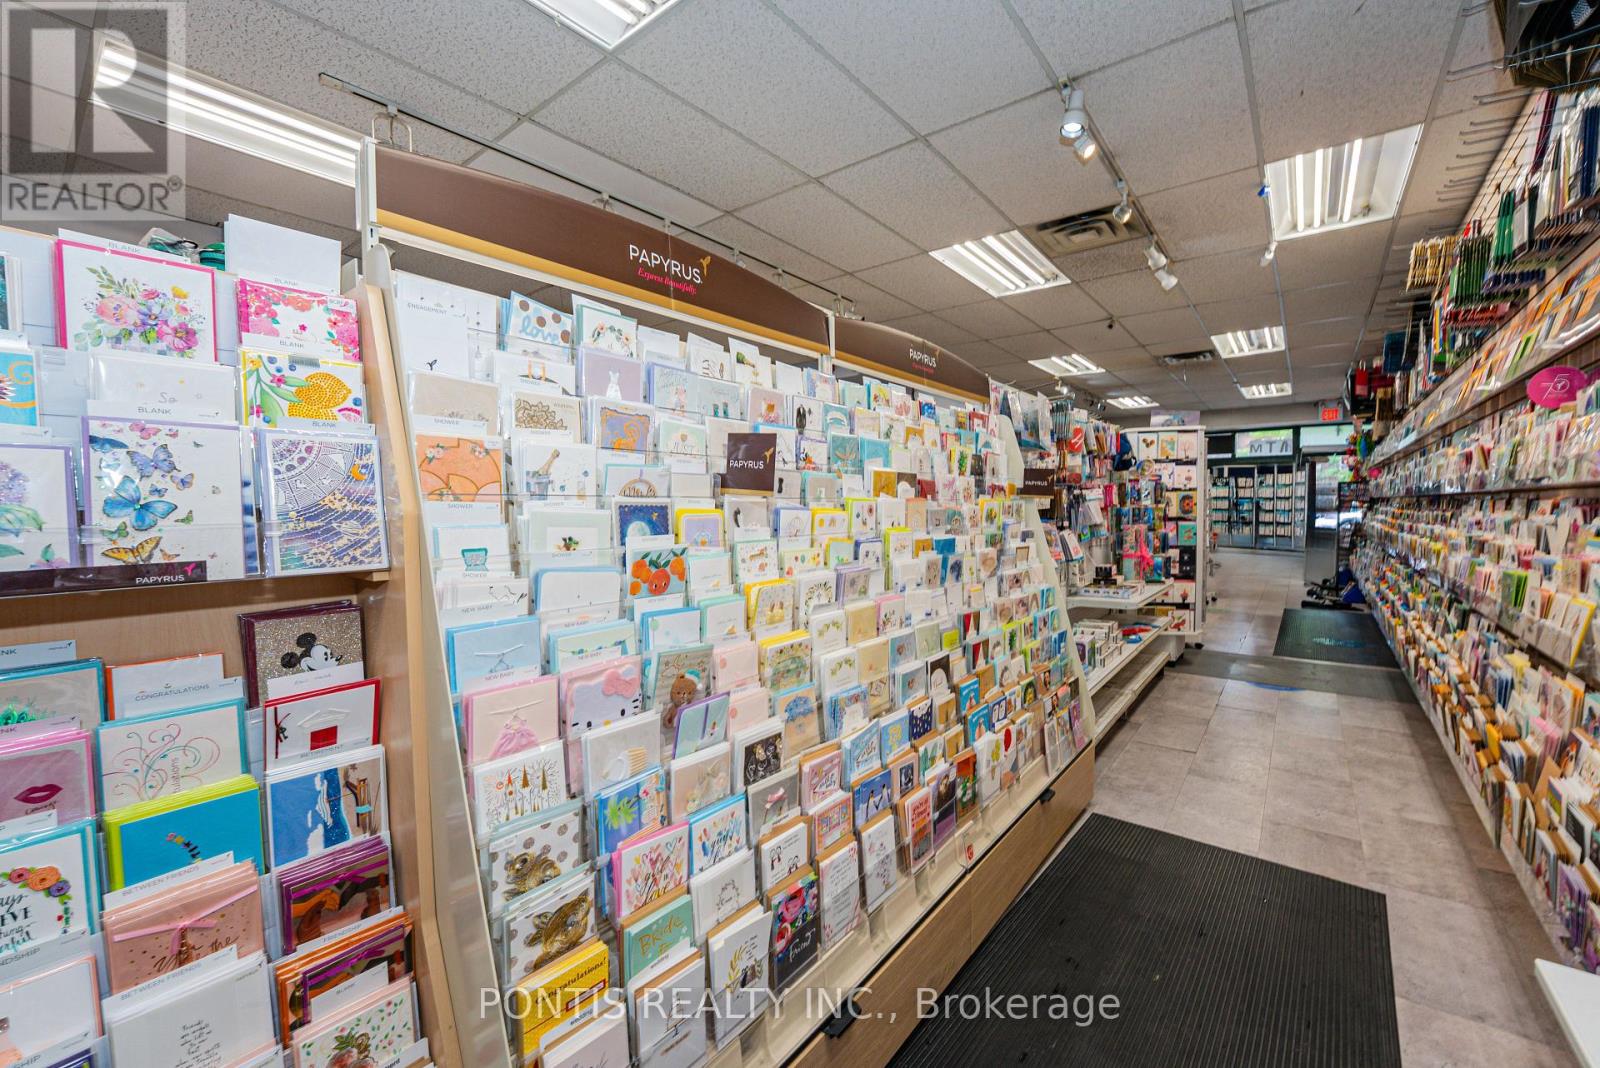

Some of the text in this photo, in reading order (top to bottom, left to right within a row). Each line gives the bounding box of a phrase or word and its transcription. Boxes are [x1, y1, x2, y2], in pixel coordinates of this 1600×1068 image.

[629, 244, 703, 284] PAPYRUS
[407, 302, 447, 315] ENGAGEMENT
[909, 348, 937, 368] PAPYRUS
[138, 406, 172, 415] BLANK
[729, 459, 764, 470] PAPYRUS
[135, 574, 185, 585] PAPYRUS
[135, 684, 210, 702] CONGRATULATIONS
